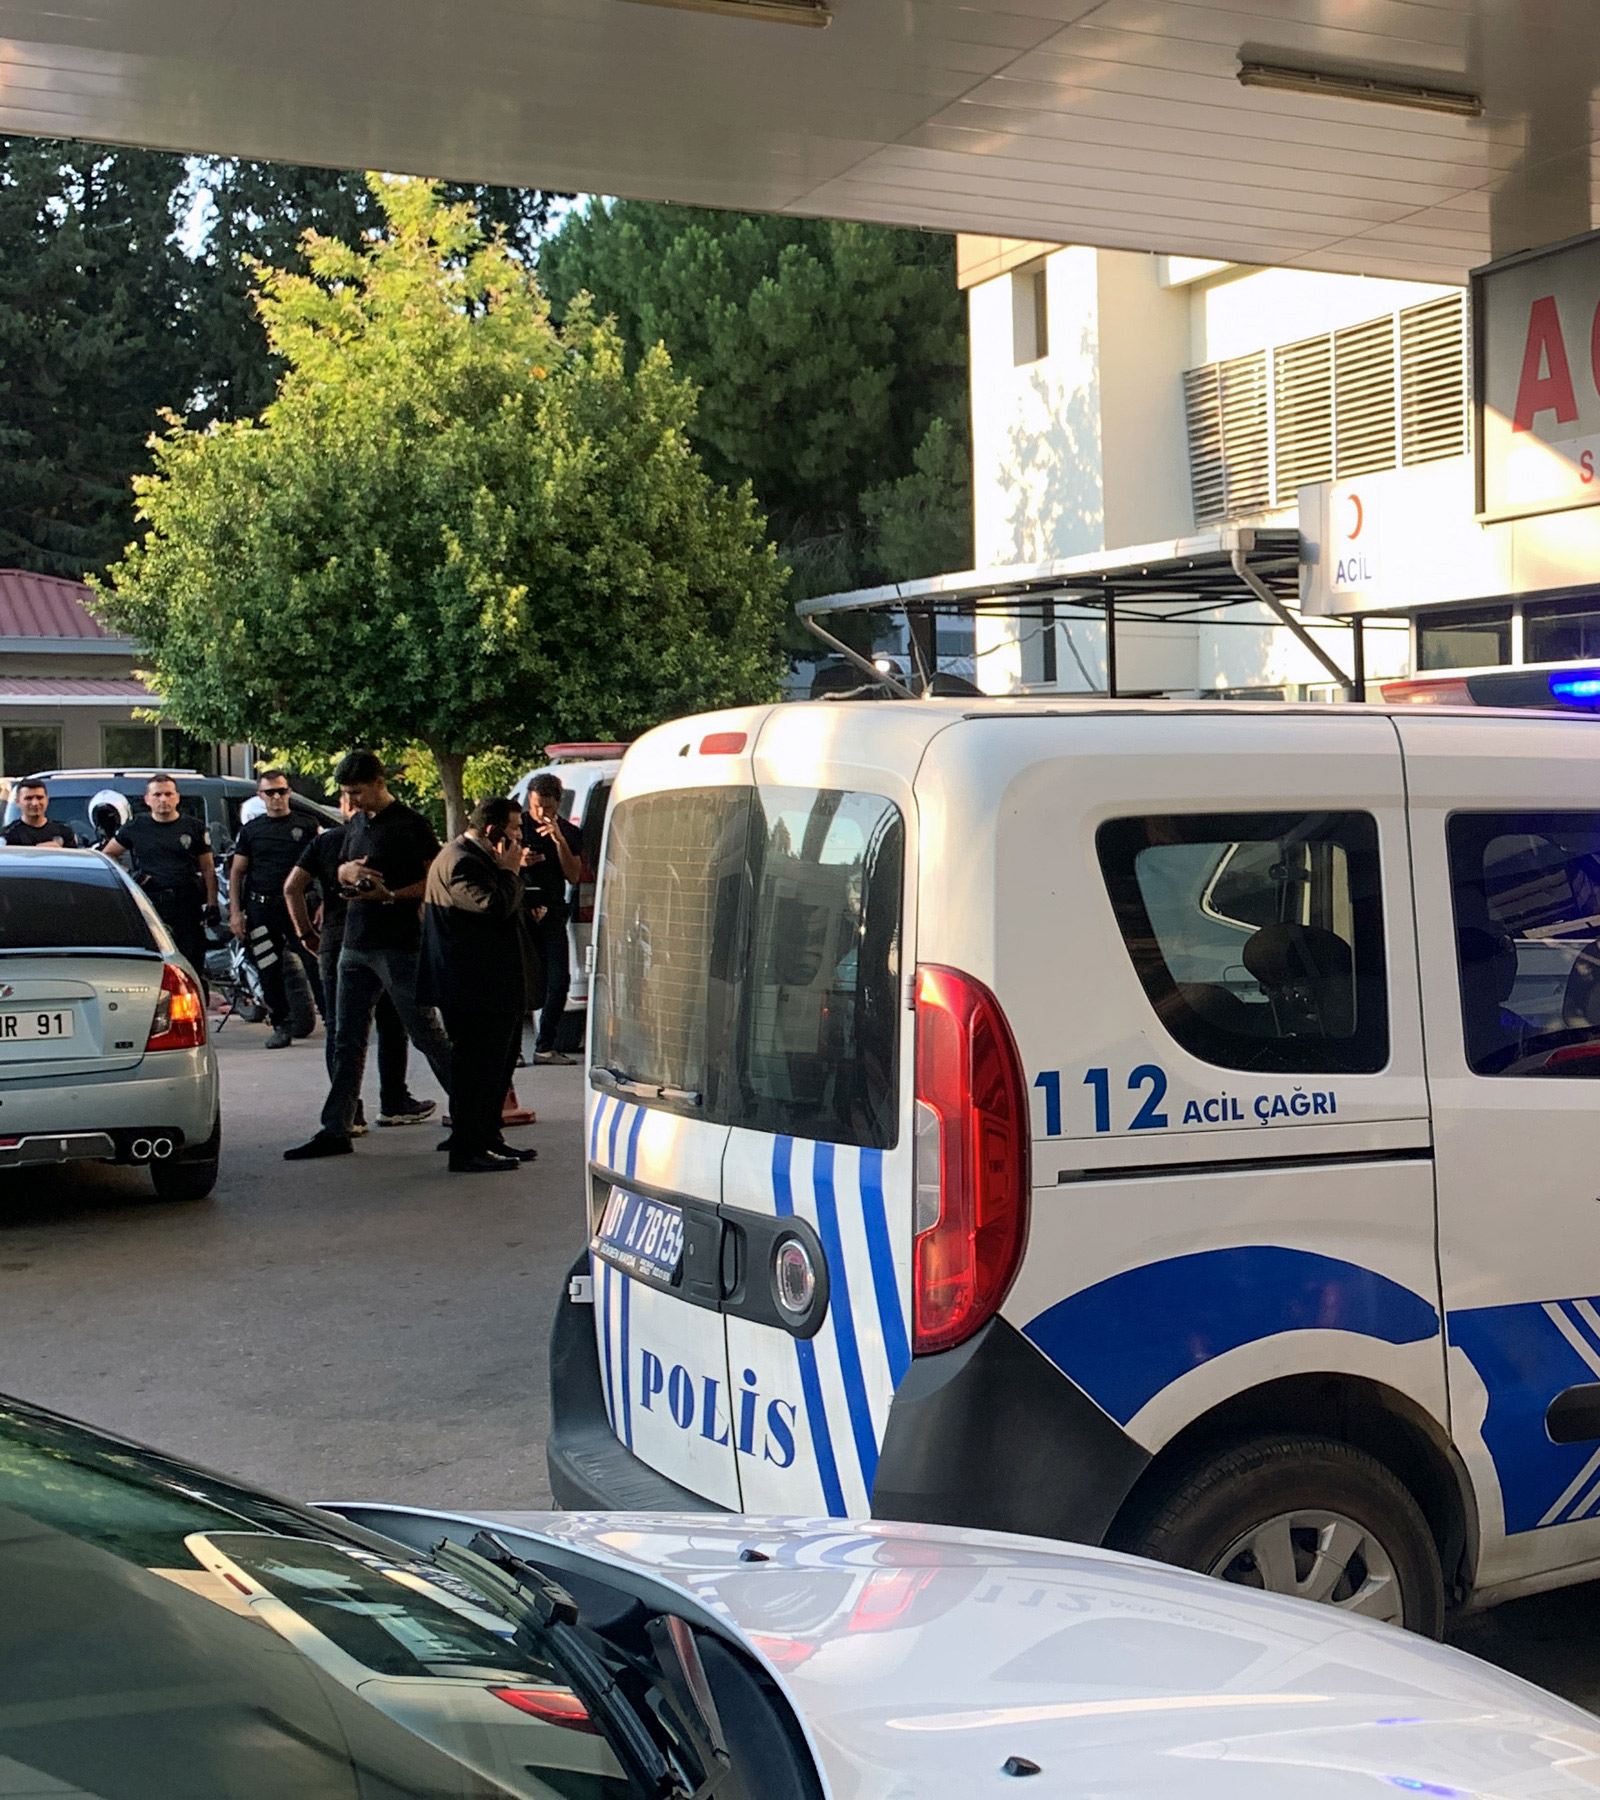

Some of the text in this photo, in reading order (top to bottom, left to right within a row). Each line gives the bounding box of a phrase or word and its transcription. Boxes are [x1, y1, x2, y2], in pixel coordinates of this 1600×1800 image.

[1336, 552, 1372, 584] ACİL
[0, 1013, 62, 1037] R 91
[1033, 1064, 1338, 1136] 112 ACİL ÇAĞRI
[606, 1193, 629, 1239] 01
[624, 1201, 644, 1247] A
[639, 1347, 797, 1469] POLİS
